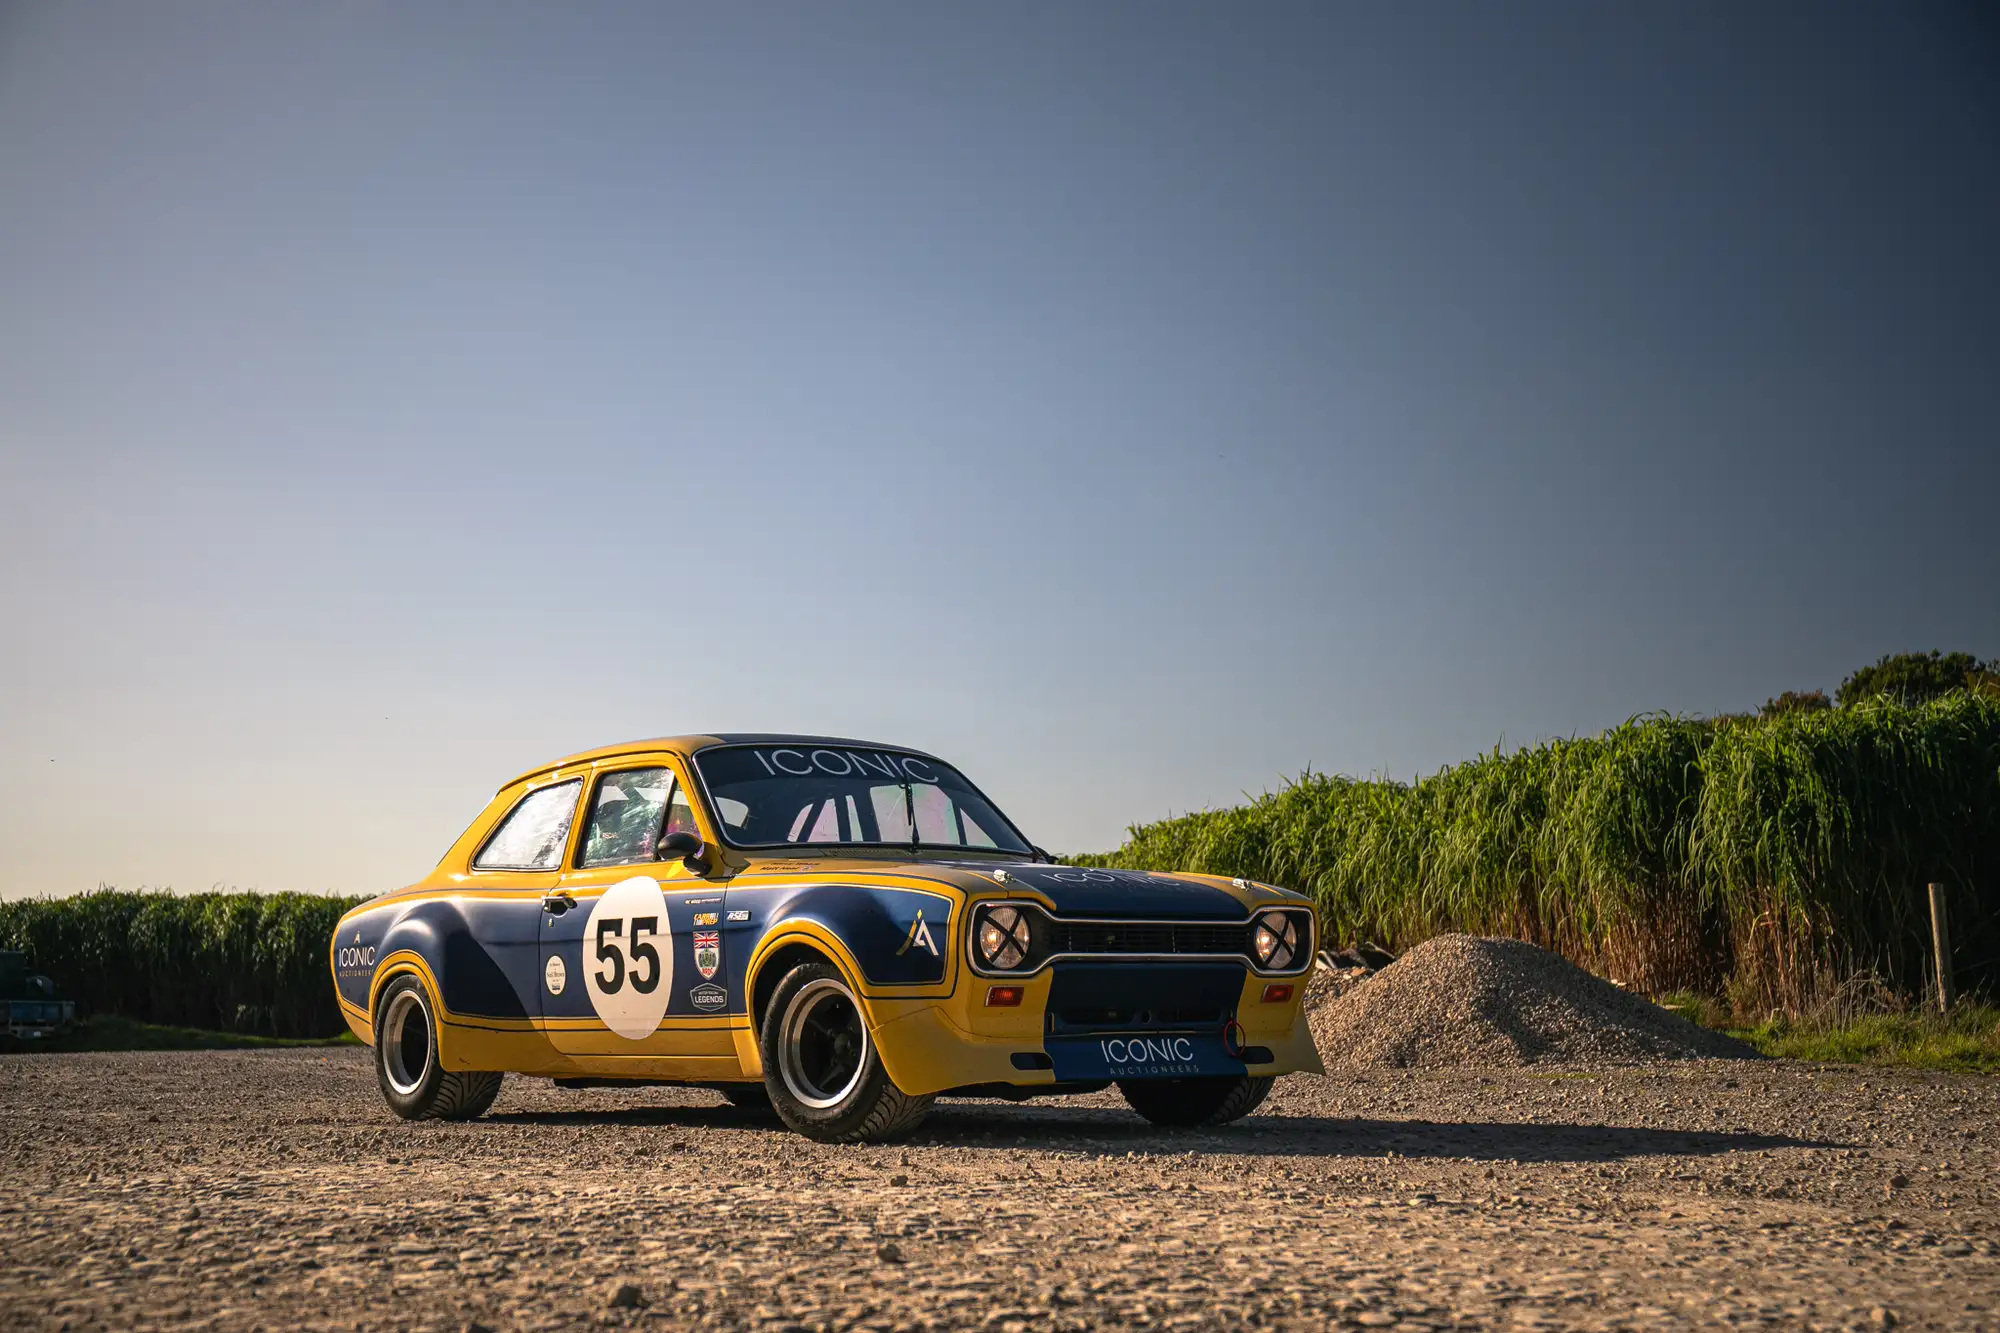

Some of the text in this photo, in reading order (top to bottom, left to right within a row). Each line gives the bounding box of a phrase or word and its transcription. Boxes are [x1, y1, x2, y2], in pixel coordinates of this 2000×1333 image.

[754, 750, 939, 783] ICONIC
[339, 946, 376, 967] ICONIC
[594, 916, 661, 995] 55
[694, 995, 724, 1004] LEGENDS
[1101, 1038, 1194, 1063] ICONIC
[1110, 1065, 1201, 1076] AUCTIONEERS
